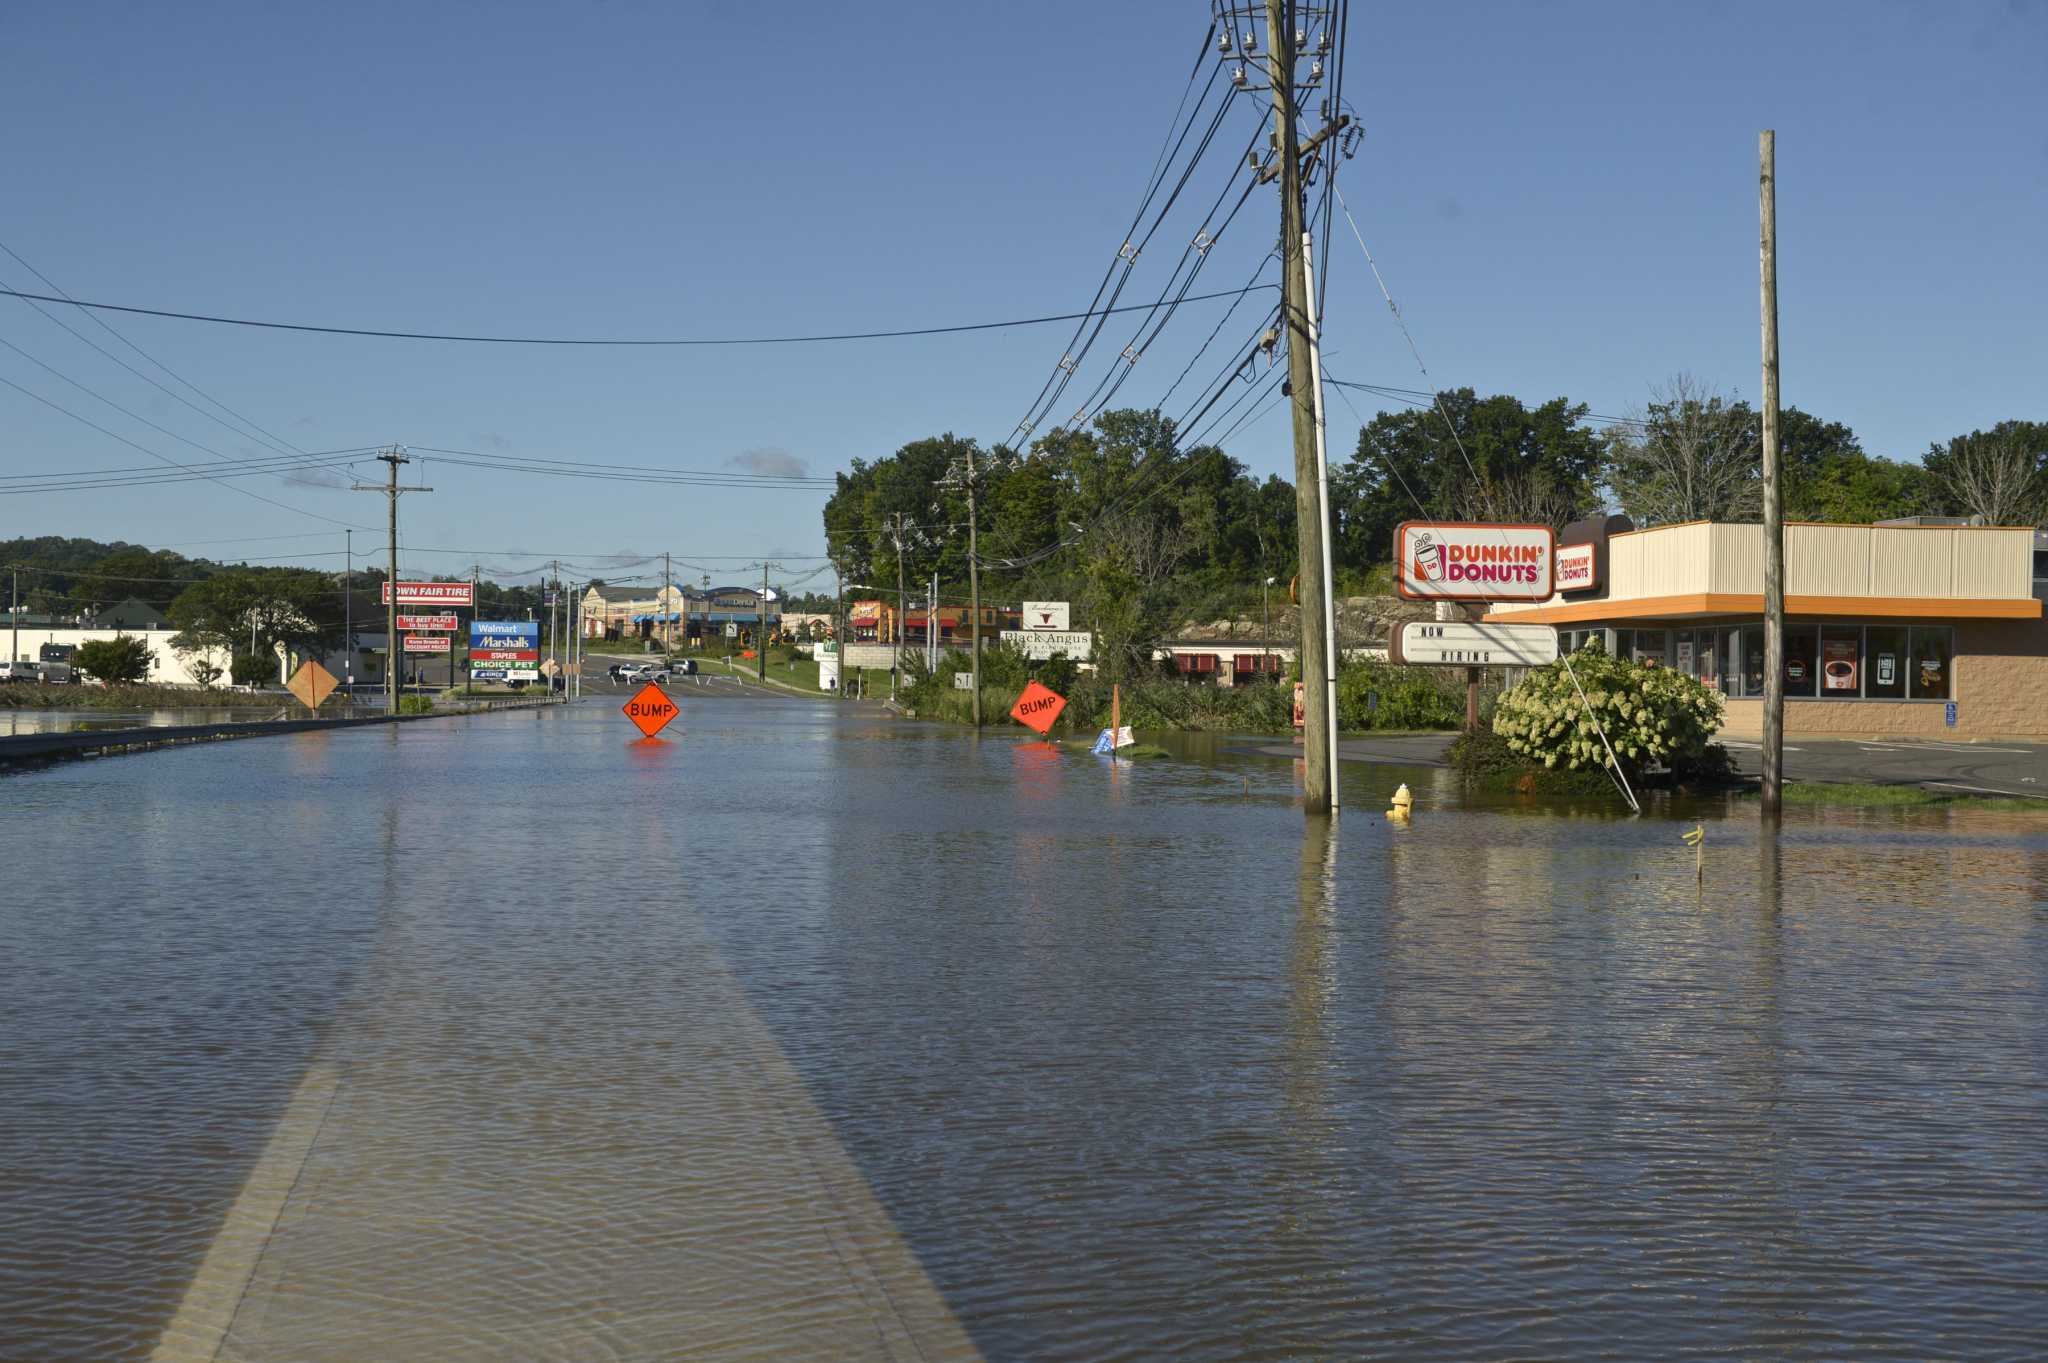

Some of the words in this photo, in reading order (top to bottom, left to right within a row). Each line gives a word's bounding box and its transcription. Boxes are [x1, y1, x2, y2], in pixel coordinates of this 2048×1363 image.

[1448, 544, 1544, 563] DUNKIN'
[1564, 556, 1590, 568] DUNKIN'
[1448, 563, 1538, 583] DONUTS
[1564, 567, 1589, 580] DONUTS
[419, 587, 444, 596] FAIR
[446, 588, 470, 597] TIRE
[478, 624, 517, 633] Walmart
[1421, 626, 1444, 637] NOW
[480, 635, 529, 648] Marshalls
[1047, 633, 1089, 646] Angus
[490, 652, 518, 660] STAPLES
[1441, 651, 1490, 662] HIRING
[630, 703, 673, 717] BUMP
[1019, 696, 1056, 717] BUMP
